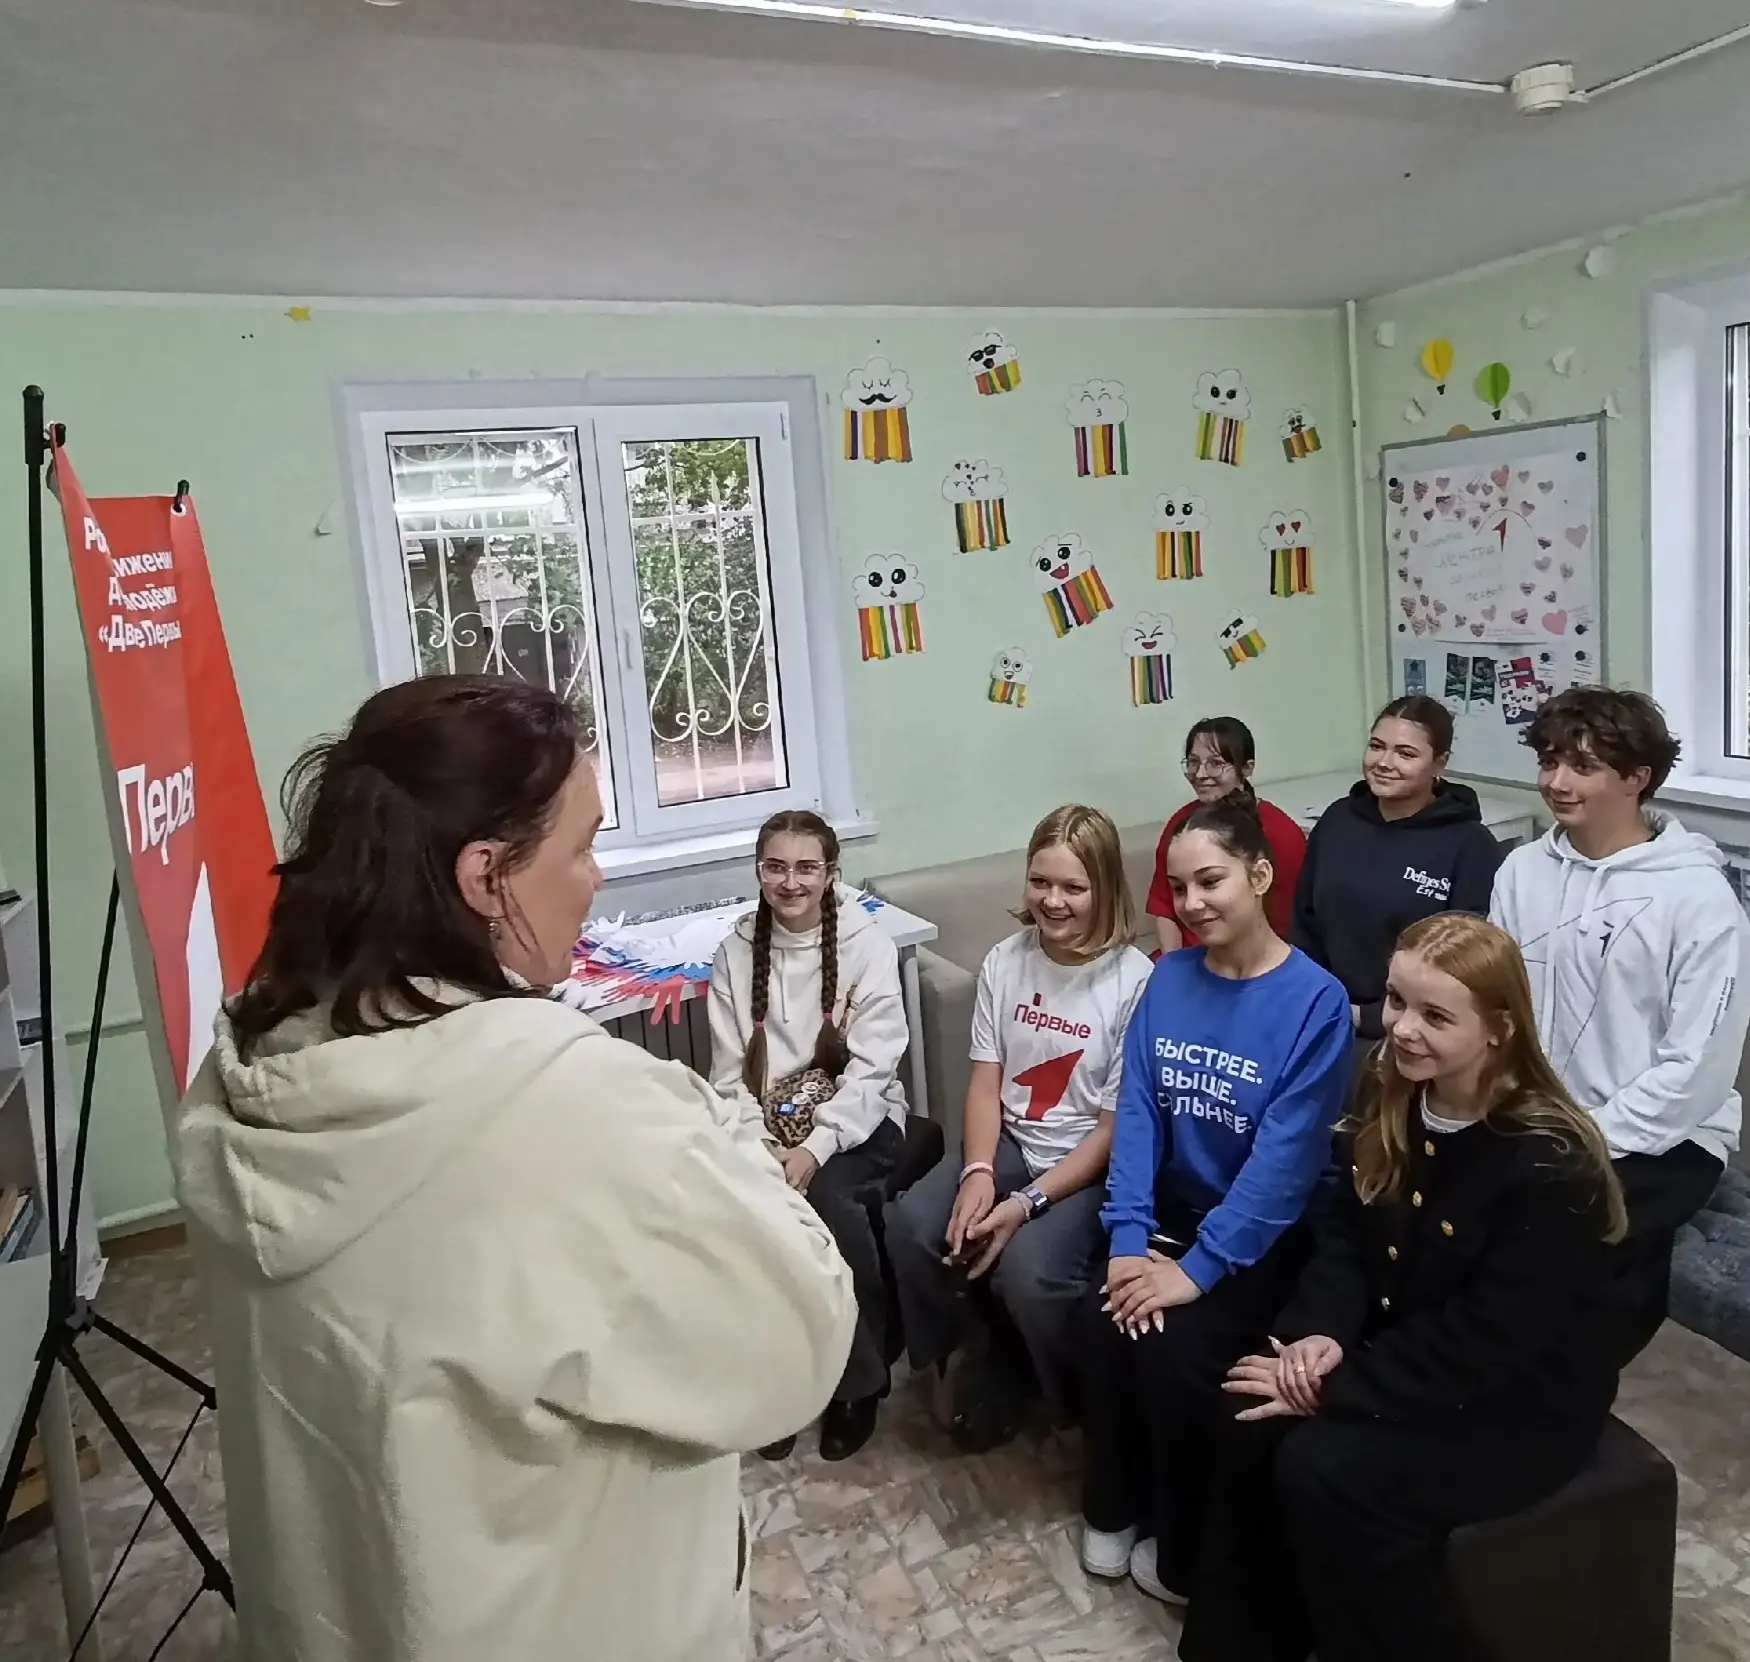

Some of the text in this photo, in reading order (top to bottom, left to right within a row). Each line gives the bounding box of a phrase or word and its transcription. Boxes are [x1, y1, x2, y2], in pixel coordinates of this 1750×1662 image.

[117, 761, 195, 866] Перв
[1013, 1003, 1091, 1039] Первые
[1155, 1037, 1263, 1085] БЫСТРЕЕ.
[1161, 1066, 1237, 1105] ВЫШЕ.
[1157, 1091, 1253, 1134] СЛЬНЕЕ.
